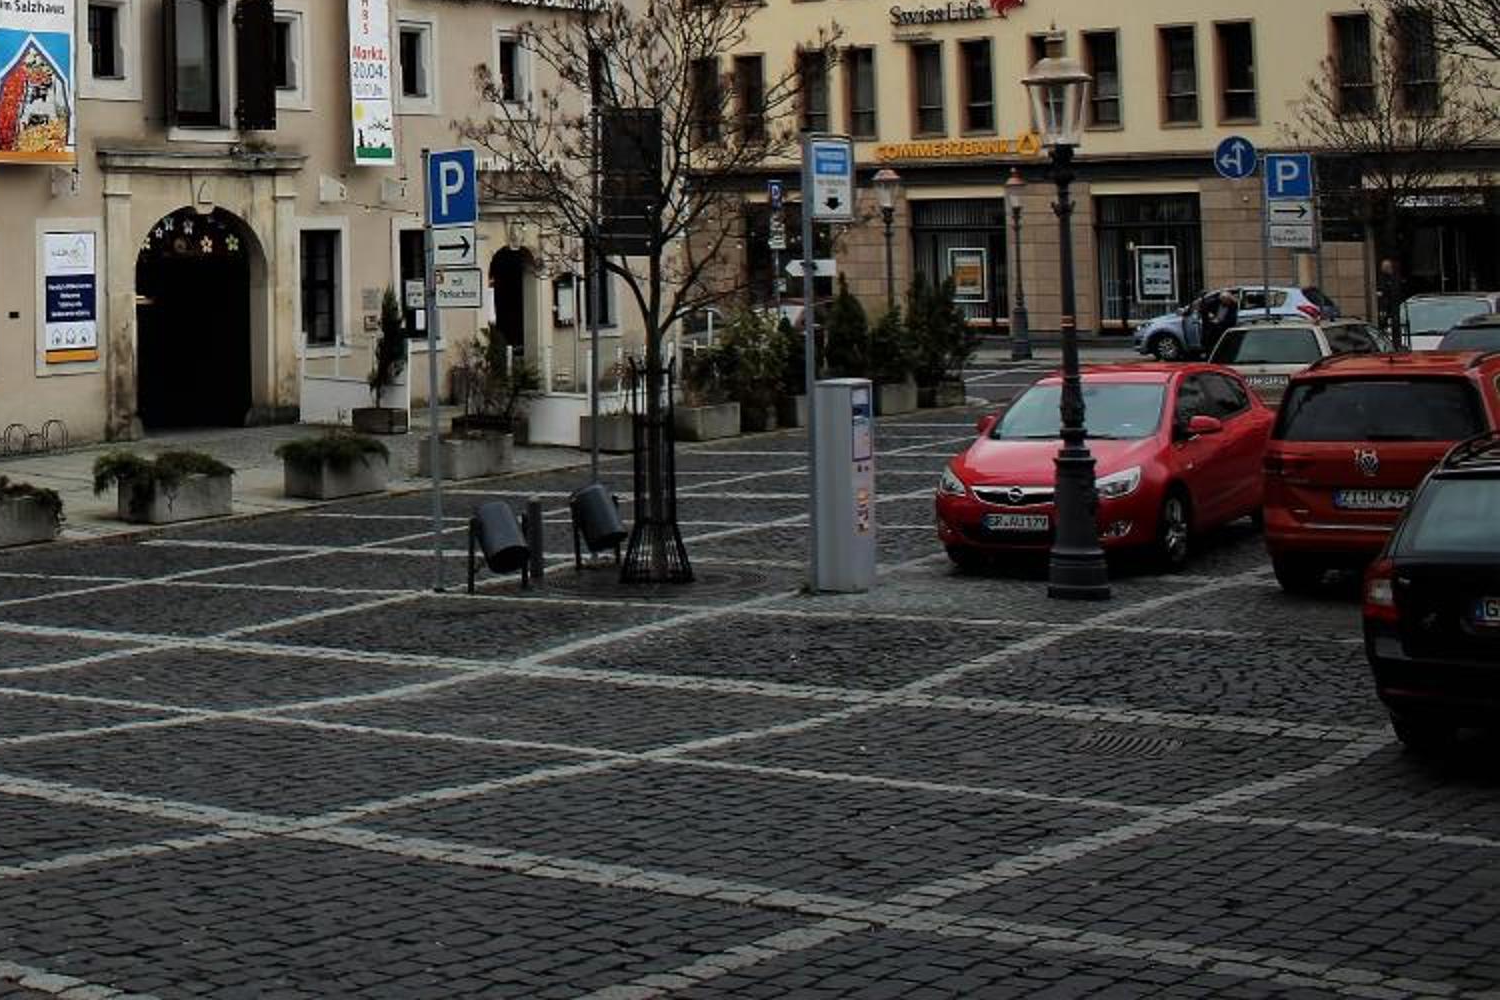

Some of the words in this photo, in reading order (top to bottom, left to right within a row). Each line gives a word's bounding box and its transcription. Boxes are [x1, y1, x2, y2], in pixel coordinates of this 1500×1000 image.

[14, 0, 65, 14] Salzhaus
[877, 140, 1009, 158] COMMERZBANK
[439, 161, 465, 216] P
[1276, 159, 1300, 193] P
